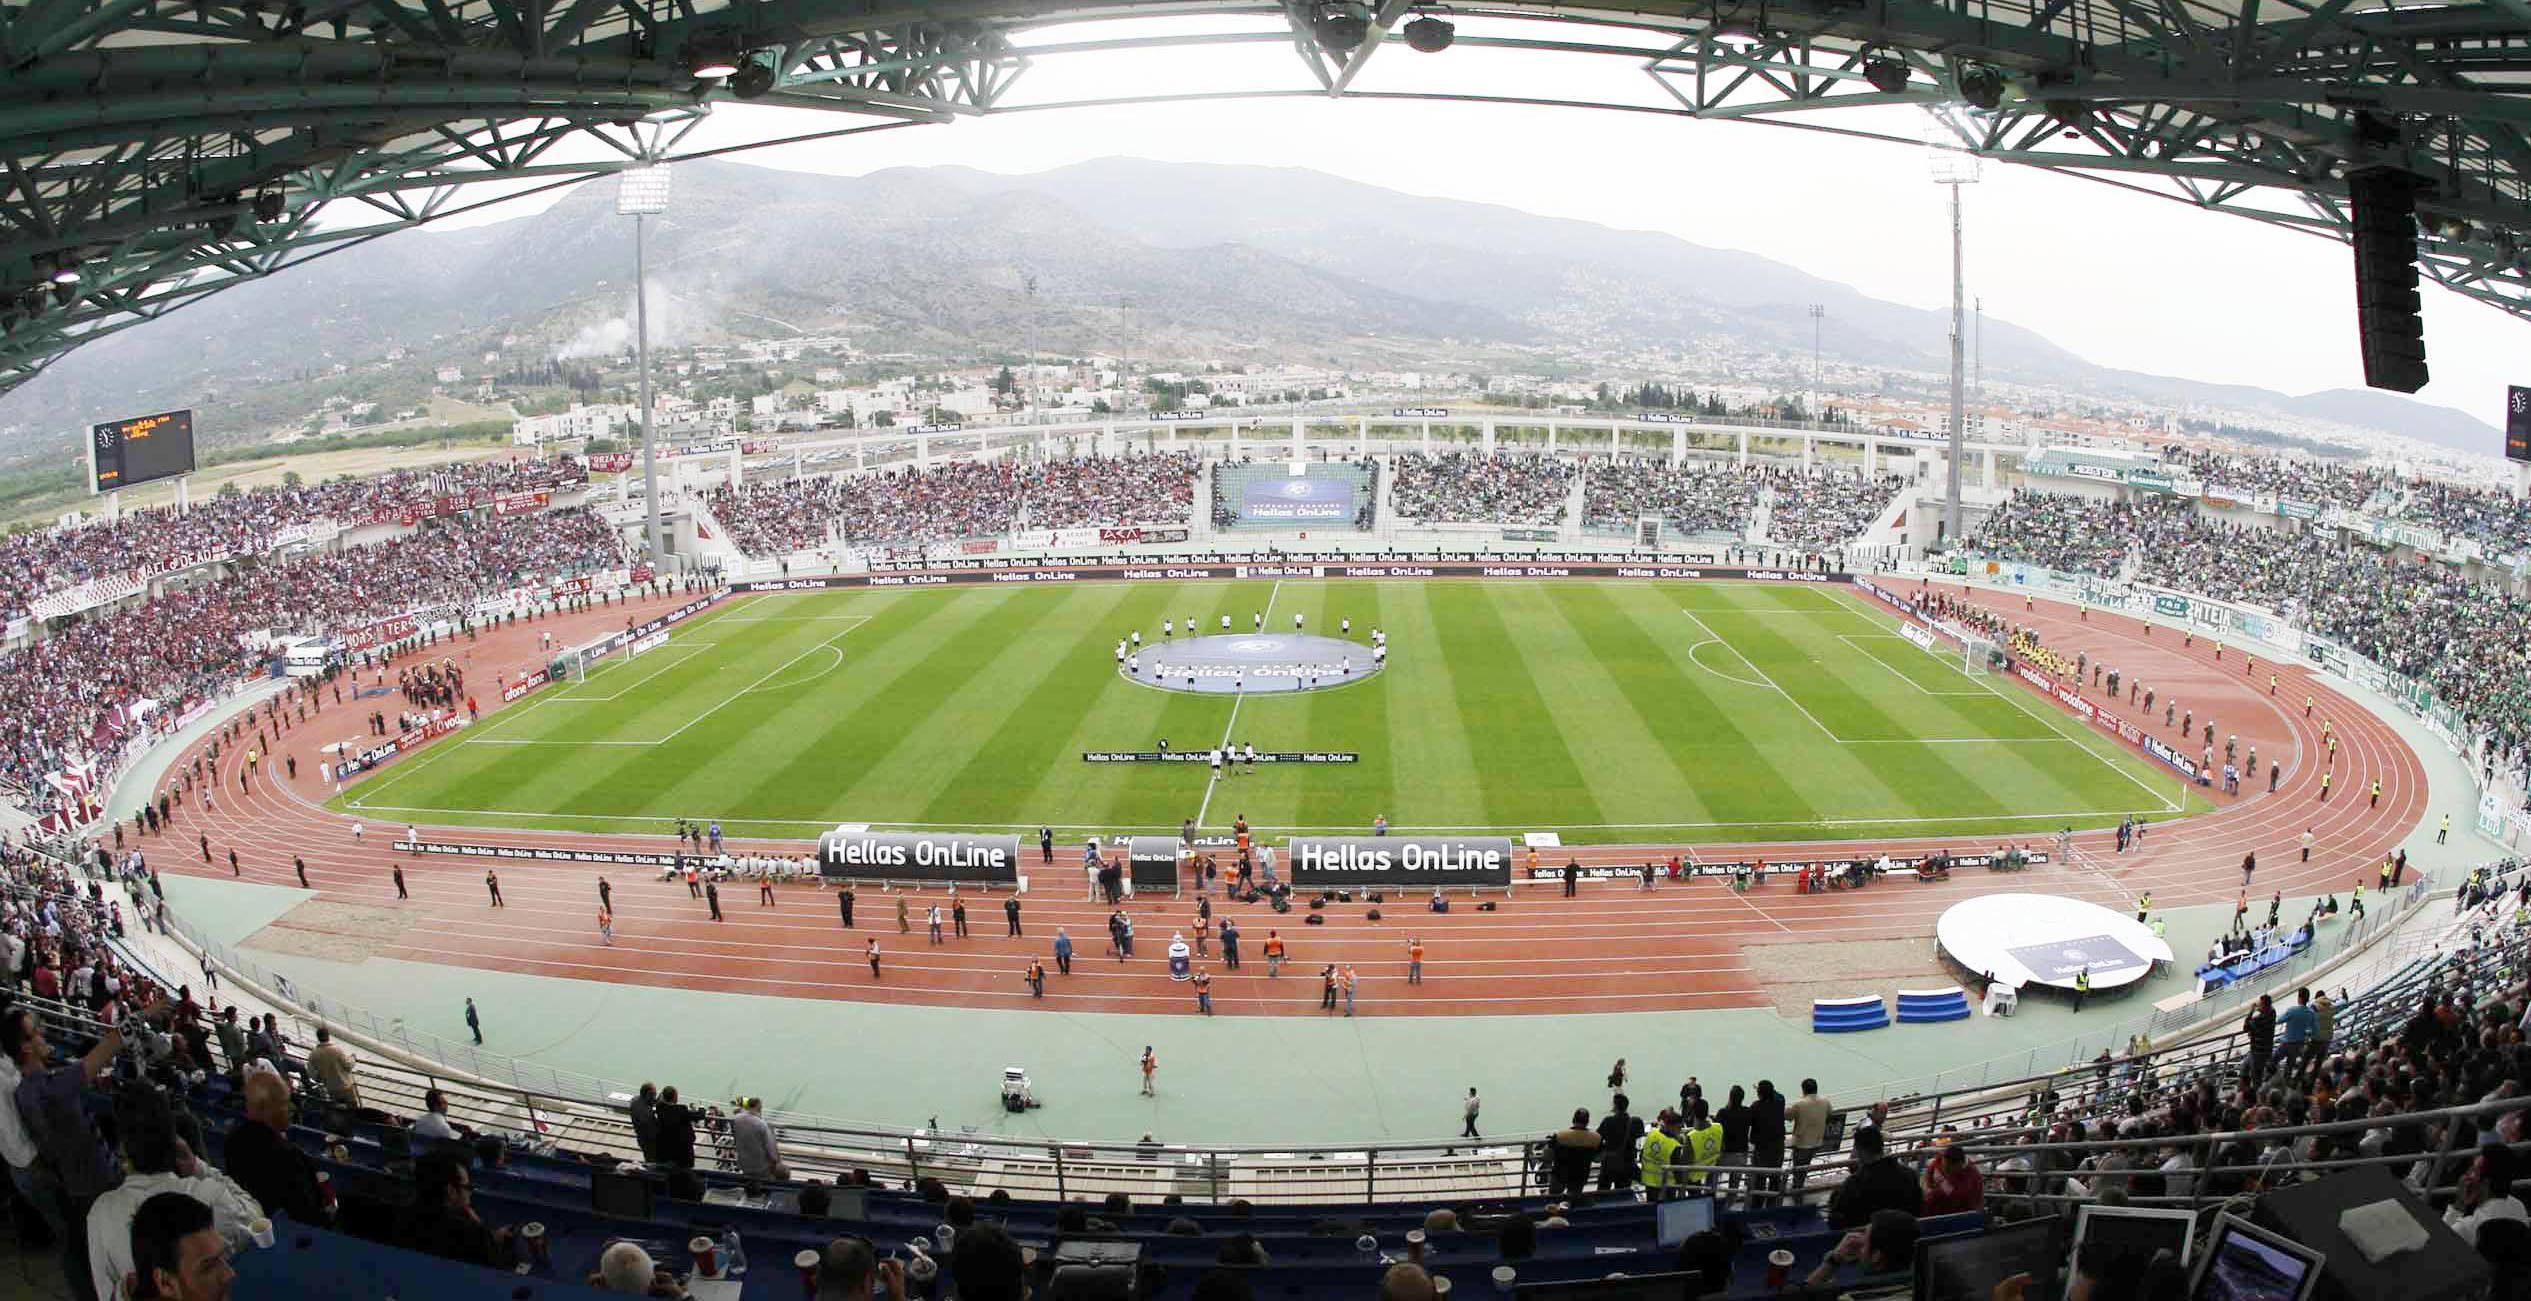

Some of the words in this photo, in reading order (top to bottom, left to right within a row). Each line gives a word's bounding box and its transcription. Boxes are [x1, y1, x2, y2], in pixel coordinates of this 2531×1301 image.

[1042, 557, 1066, 567] Hellas
[1070, 556, 1098, 566] OnLine
[1102, 556, 1128, 566] Hellas
[1130, 555, 1158, 565] OnLine
[1162, 554, 1189, 564] Hellas
[1191, 554, 1220, 563] OnLine
[1224, 554, 1250, 563] Hellas
[1253, 554, 1282, 562] OnLine
[1286, 554, 1313, 562] Hellas
[1316, 553, 1344, 562] OnLine
[1350, 553, 1376, 562] Hellas
[1378, 553, 1408, 562] OnLine
[1412, 553, 1439, 562] Hellas
[1442, 553, 1470, 562] OnLine
[1474, 553, 1500, 562] Hellas
[1503, 553, 1532, 562] OnLine
[1536, 553, 1562, 562] Hellas
[1564, 553, 1592, 562] OnLine
[1597, 553, 1623, 563] Hellas
[1625, 554, 1653, 563] OnLine
[1657, 554, 1682, 564] Hellas
[1684, 554, 1712, 564] OnLine
[872, 562, 896, 572] Hellas
[897, 560, 922, 570] OnLine
[926, 560, 951, 570] Hellas
[952, 559, 980, 569] OnLine
[983, 558, 1008, 568] Hellas
[1010, 558, 1038, 568] OnLine
[1124, 568, 1162, 579] Hellas
[1168, 568, 1209, 578] OnLine
[1258, 566, 1283, 576] Hellas
[1284, 566, 1312, 575] OnLine
[1346, 566, 1386, 576] Hellas
[1391, 566, 1434, 576] OnLine
[1484, 566, 1522, 576] Hellas
[1528, 567, 1568, 576] OnLine
[1618, 568, 1655, 578] Hellas
[1660, 568, 1700, 578] OnLine
[1747, 570, 1783, 580] Hellas
[1788, 570, 1827, 582] OnLine
[870, 576, 904, 585] Hellas
[908, 574, 947, 583] OnLine
[993, 572, 1030, 582] Hellas
[1034, 571, 1076, 580] OnLine
[750, 582, 784, 591] Hellas
[788, 580, 826, 590] OnLine
[648, 620, 662, 632] Line
[591, 645, 608, 659] Line
[2058, 690, 2094, 716] vodafone
[829, 838, 906, 865] Hellas
[915, 840, 1006, 868] OnLine
[1302, 844, 1392, 871] Hellas
[1402, 844, 1500, 870] OnLine
[1590, 868, 1613, 878] Hellas
[1615, 868, 1640, 877] OnLine
[1702, 866, 1725, 874] Hellas
